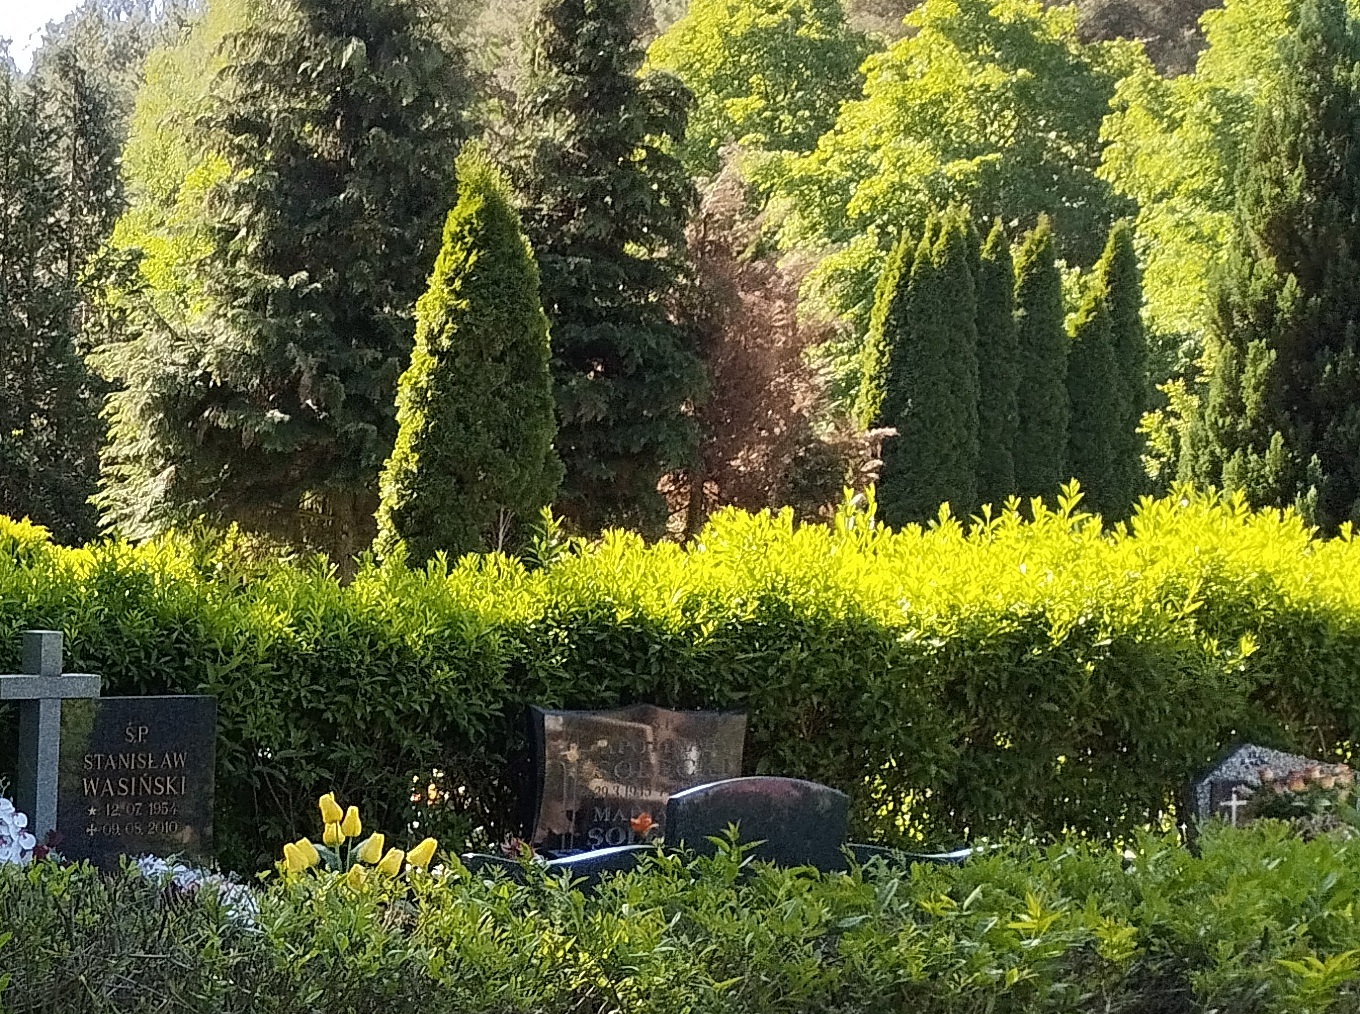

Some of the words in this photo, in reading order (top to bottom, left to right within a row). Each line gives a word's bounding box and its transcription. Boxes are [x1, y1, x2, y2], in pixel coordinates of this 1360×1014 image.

[83, 751, 188, 770] STANISŁAW
[82, 773, 187, 796] WASIŃSKI
[149, 801, 178, 816] 1954
[148, 821, 178, 835] 2010
